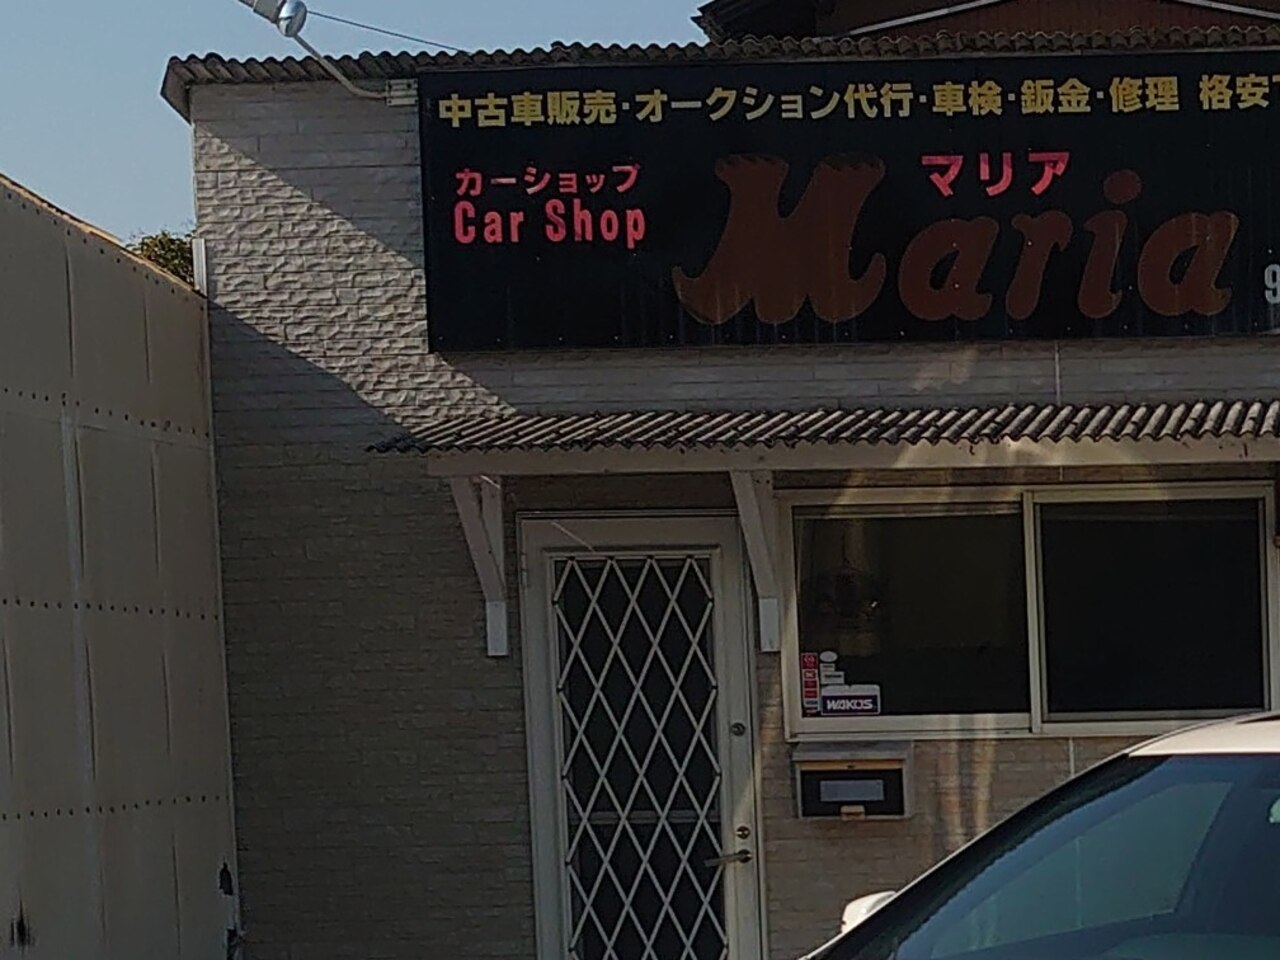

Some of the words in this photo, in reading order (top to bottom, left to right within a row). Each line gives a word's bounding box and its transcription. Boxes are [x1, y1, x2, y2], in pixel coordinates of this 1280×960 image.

[455, 163, 642, 196] カーショップ
[921, 152, 1071, 197] マリア
[454, 199, 524, 243] Car
[545, 198, 647, 249] Shop
[673, 152, 1240, 324] Maria
[827, 699, 873, 711] WAKOS
